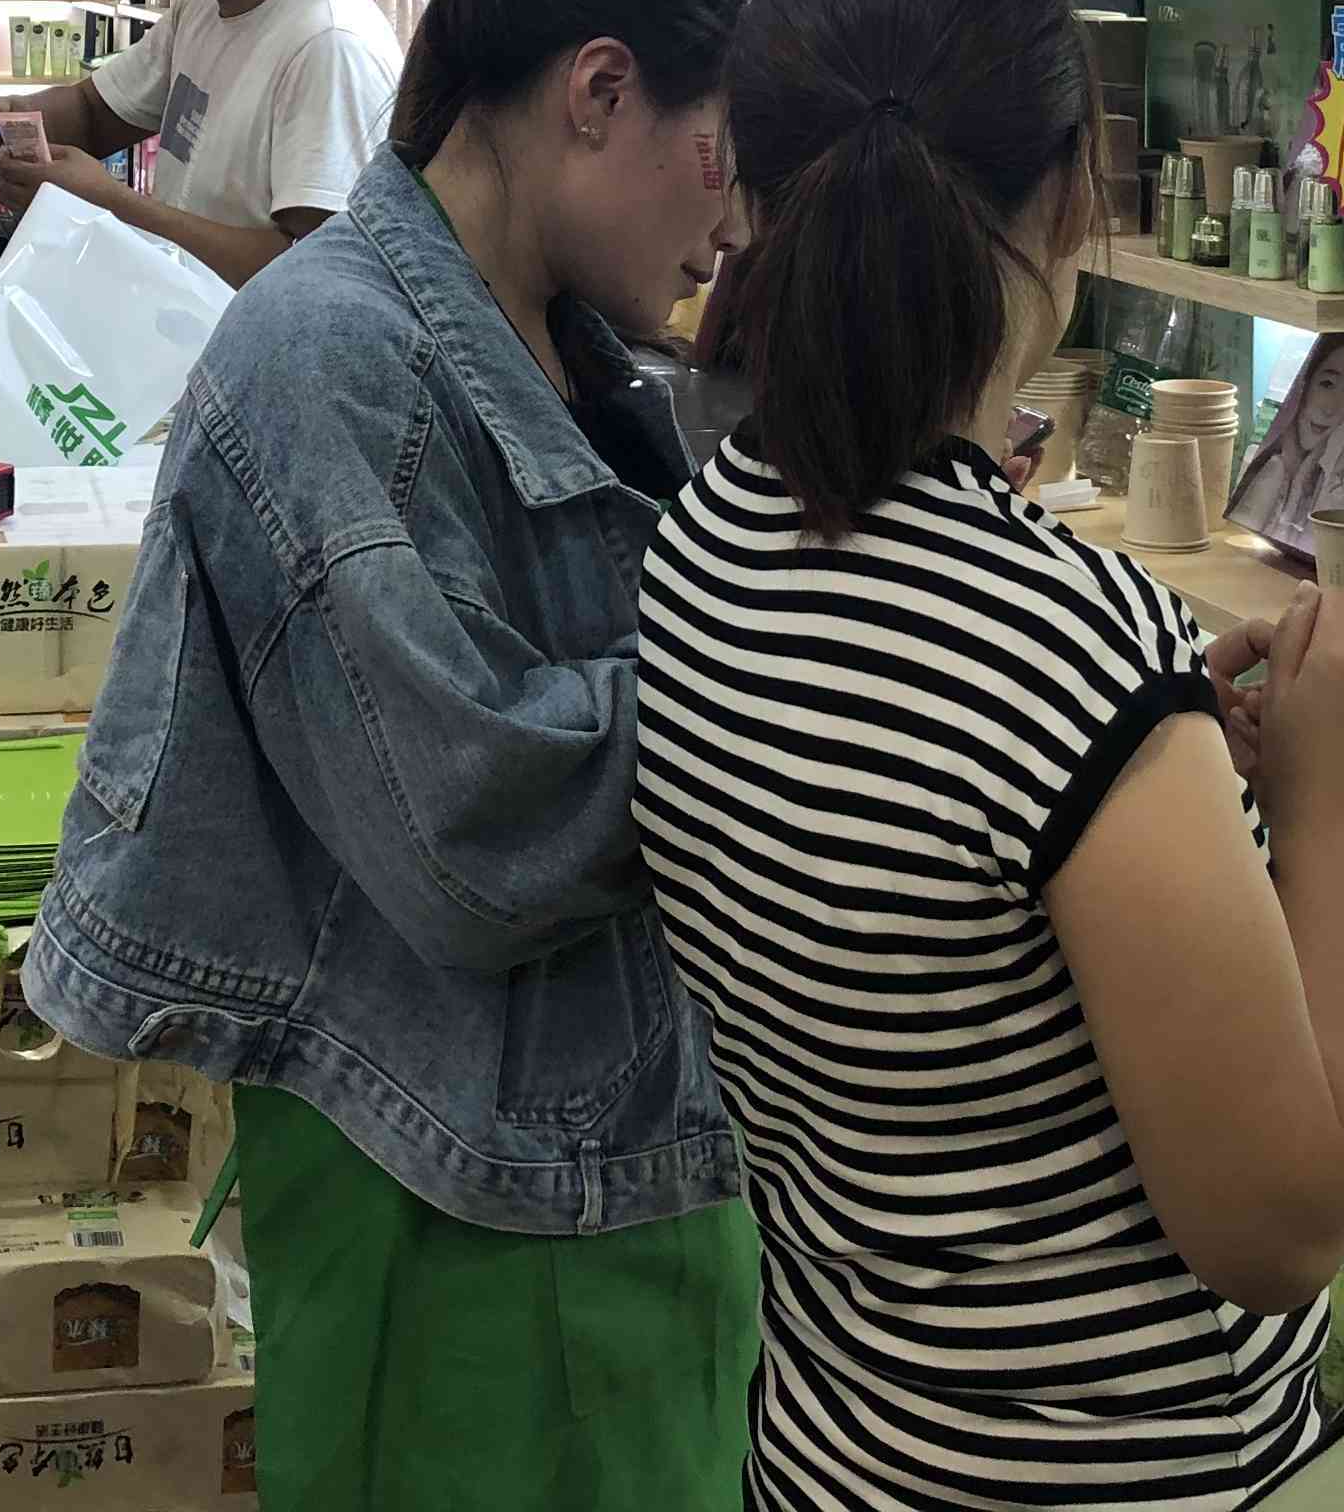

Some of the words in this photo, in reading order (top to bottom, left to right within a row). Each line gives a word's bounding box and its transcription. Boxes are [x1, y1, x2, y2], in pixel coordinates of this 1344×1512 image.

[0, 617, 74, 632] 健康好生活
